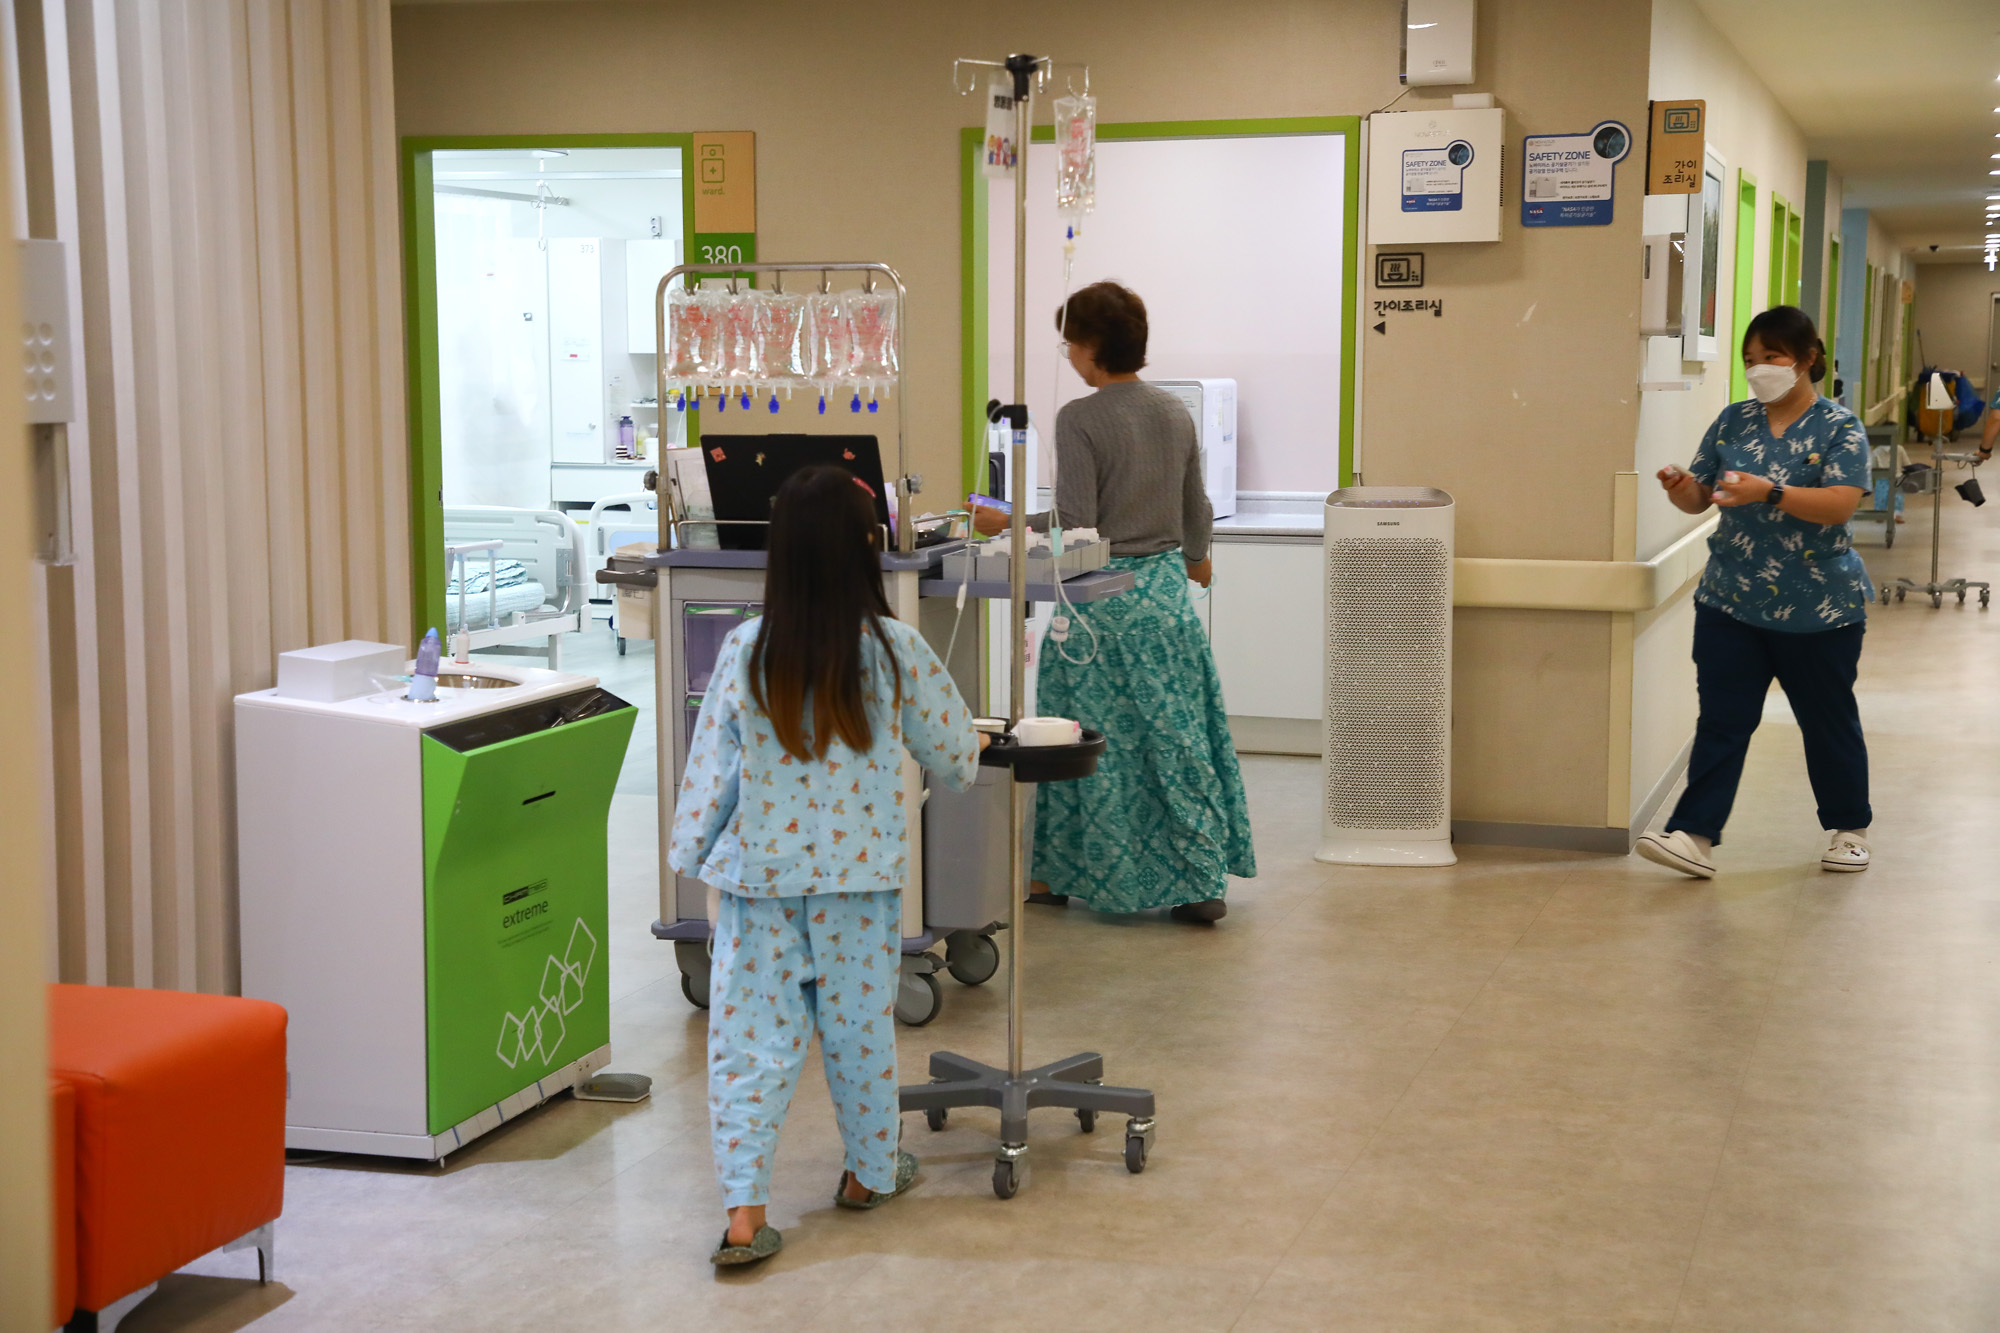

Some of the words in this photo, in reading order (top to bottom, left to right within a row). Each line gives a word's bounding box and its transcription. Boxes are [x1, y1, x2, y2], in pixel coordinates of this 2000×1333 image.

[1529, 152, 1564, 161] SAFETY
[1565, 151, 1591, 160] ZONE
[1674, 160, 1697, 174] 간이
[1663, 174, 1696, 188] 조리실
[701, 245, 742, 264] 380
[1373, 299, 1442, 317] 간이조리실
[502, 900, 549, 929] extreme
